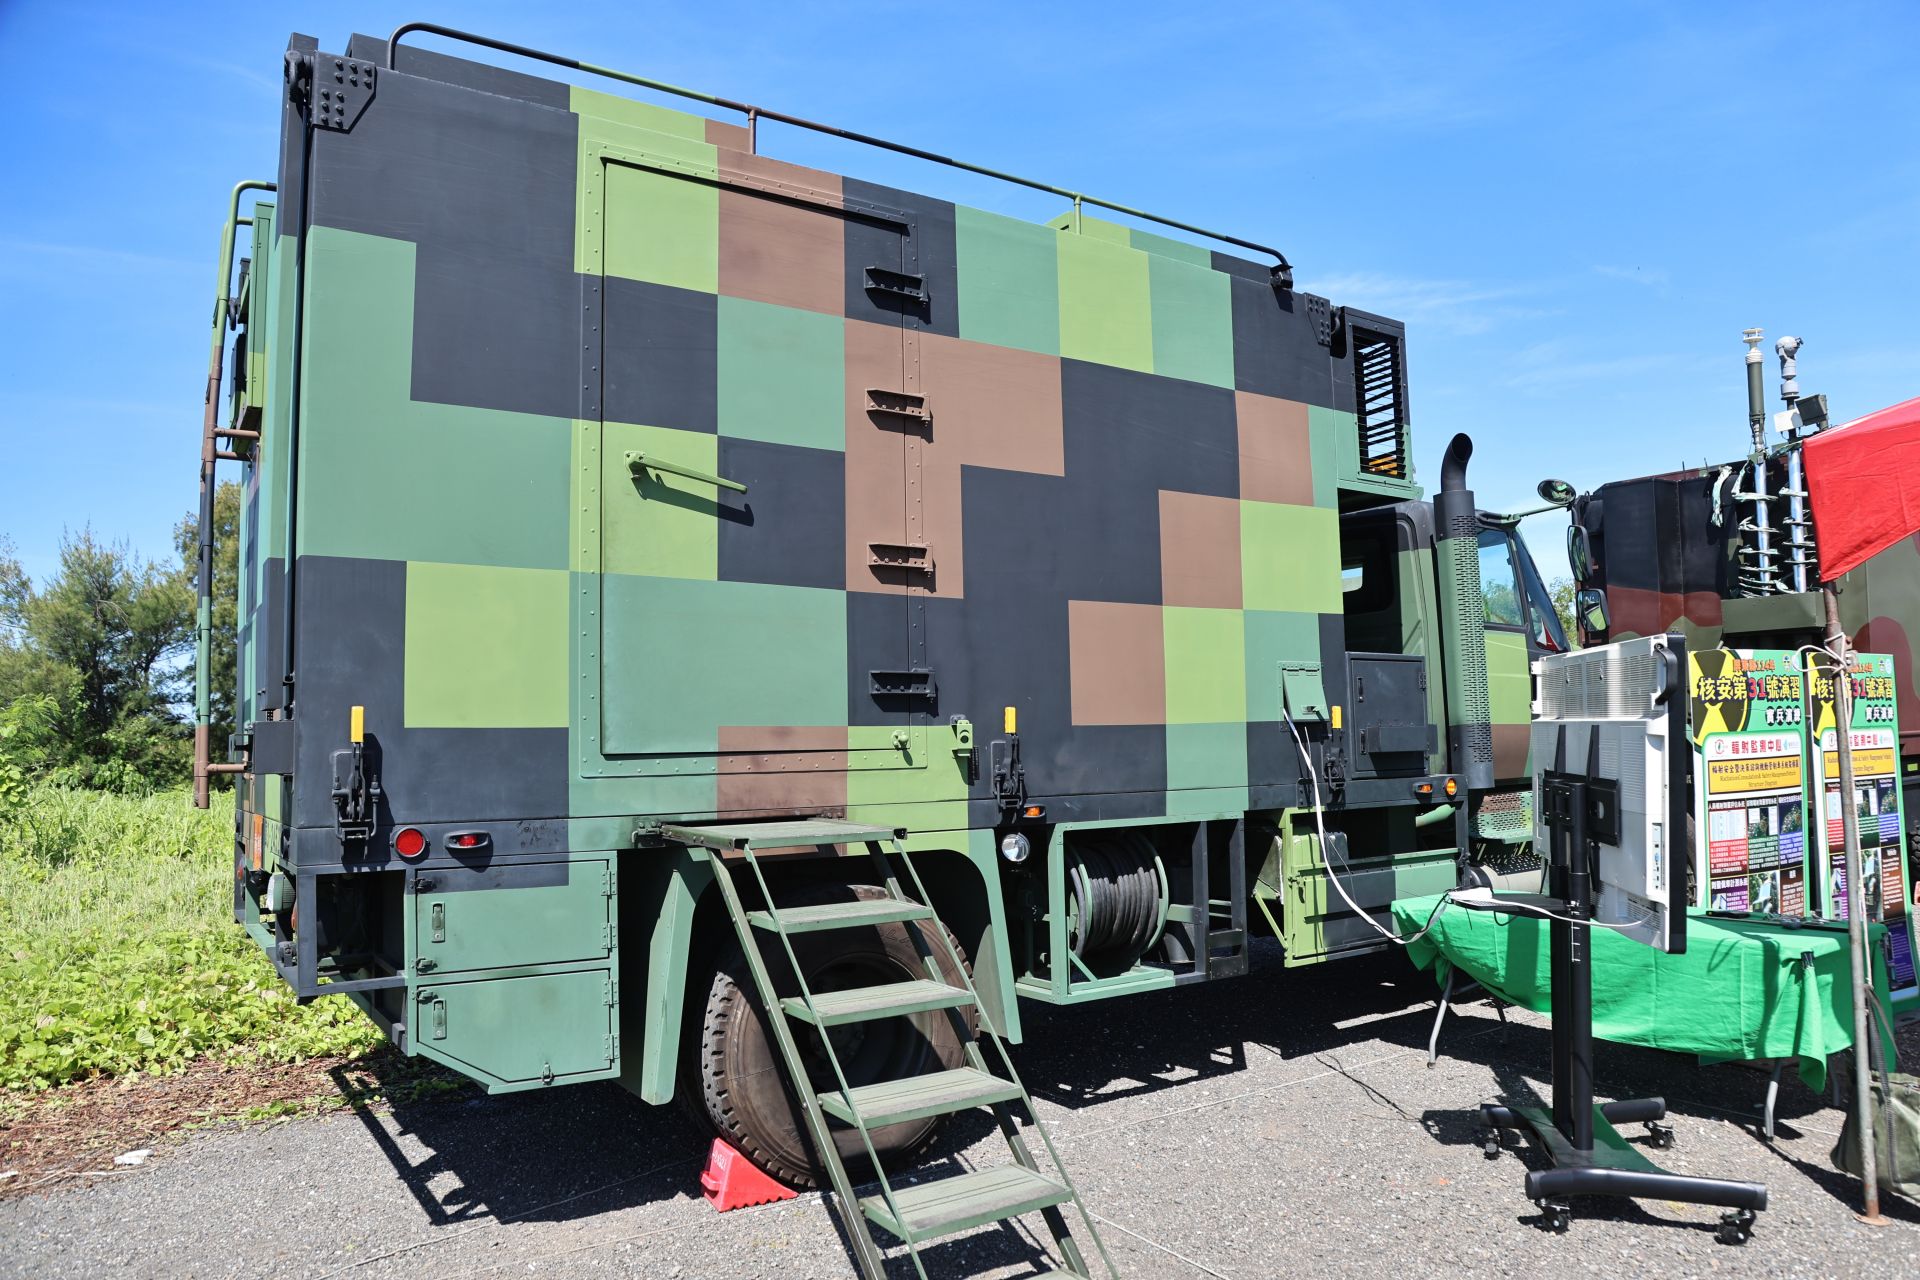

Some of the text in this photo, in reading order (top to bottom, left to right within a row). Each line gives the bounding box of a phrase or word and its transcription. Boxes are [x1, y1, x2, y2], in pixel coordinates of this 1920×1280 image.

[1698, 675, 1801, 701] 核安第31號演習
